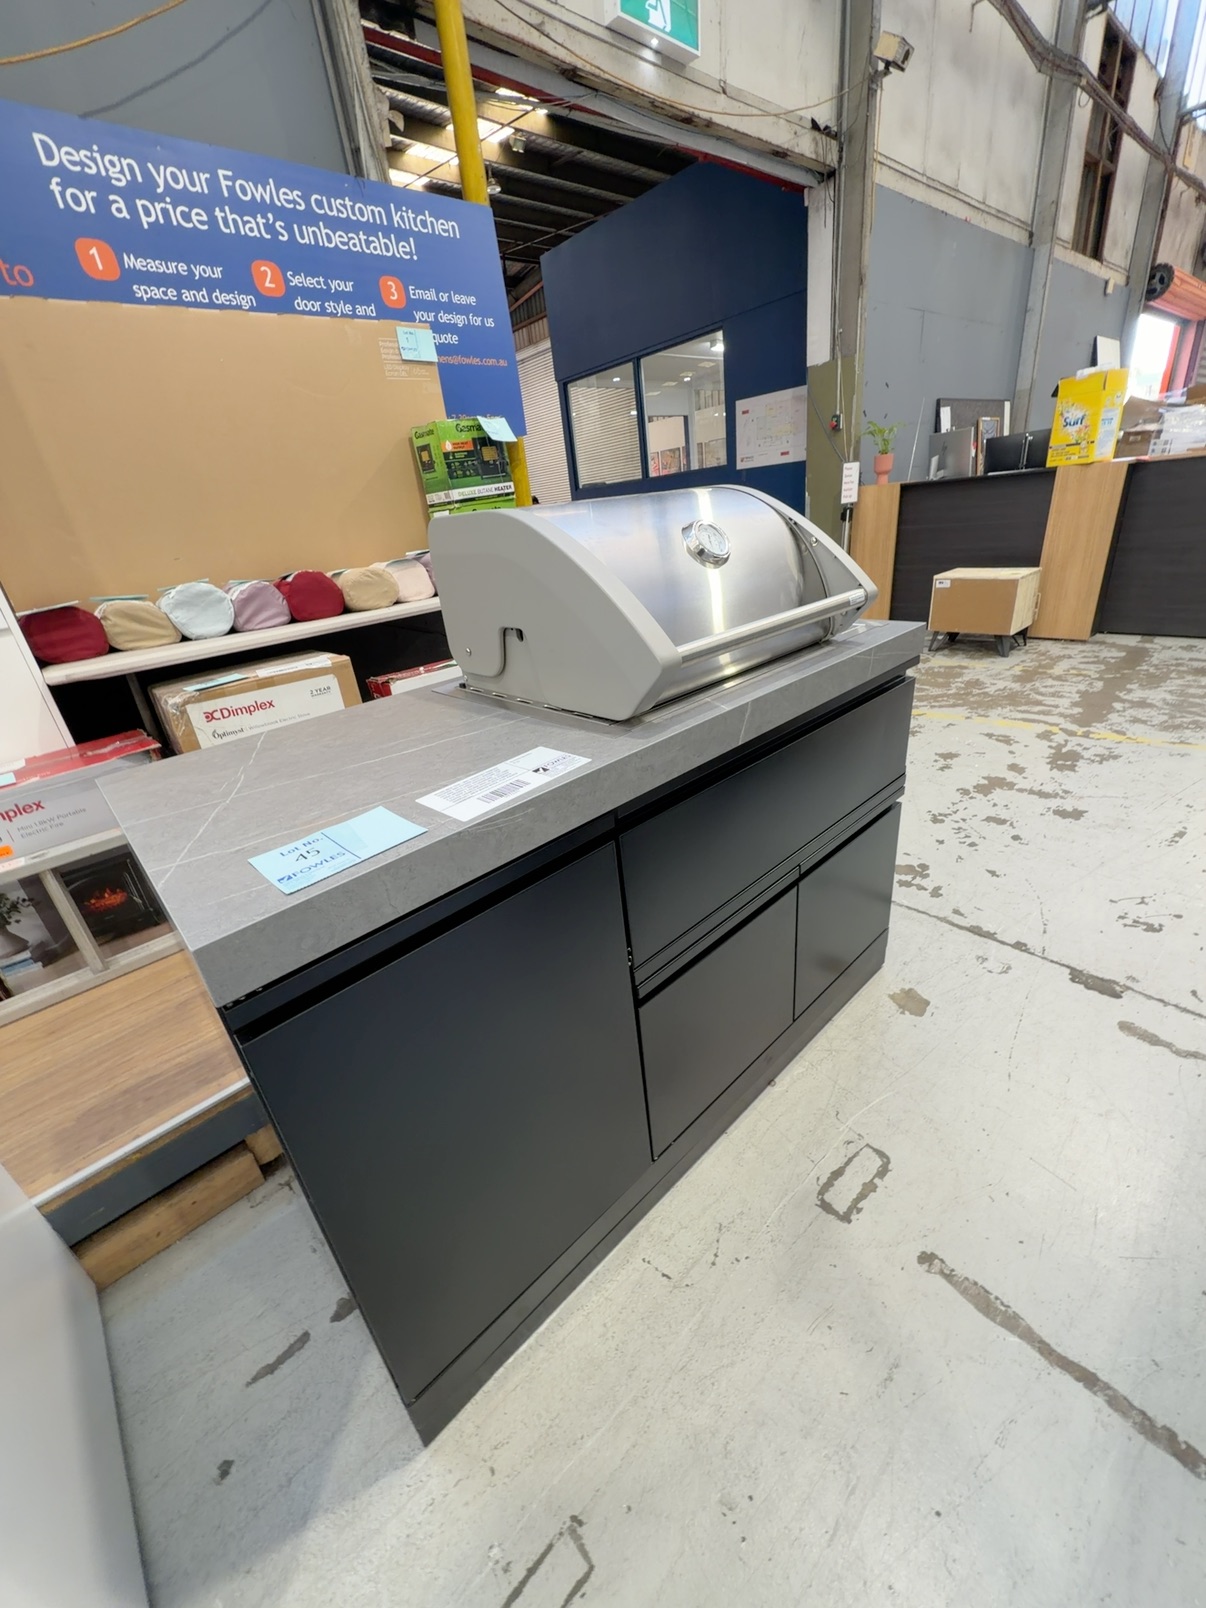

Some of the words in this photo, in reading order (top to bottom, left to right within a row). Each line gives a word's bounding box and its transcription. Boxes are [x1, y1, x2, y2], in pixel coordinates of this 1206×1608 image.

[31, 131, 143, 187] Design
[147, 162, 210, 194] your
[217, 169, 306, 211] Fowles
[311, 194, 387, 226] custom
[390, 203, 461, 239] kitchen
[49, 176, 97, 214] for
[108, 194, 131, 220] a
[135, 196, 209, 230] price
[214, 205, 289, 242] that's
[293, 221, 418, 260] unbeatable!
[88, 246, 103, 271] 1
[123, 252, 188, 276] Measure
[191, 263, 223, 280] your
[0, 259, 35, 287] to
[259, 265, 276, 288] 2
[286, 271, 326, 290] Select
[328, 278, 354, 293] your
[132, 283, 178, 301] space
[181, 287, 209, 304] and
[212, 288, 257, 310] design
[386, 281, 399, 300] 3
[408, 285, 438, 302] Email
[439, 291, 449, 302] or
[450, 290, 477, 306] leave
[294, 296, 322, 312] door
[325, 299, 353, 317] style
[355, 303, 376, 317] and
[413, 310, 436, 324] your
[437, 310, 468, 328] design
[469, 314, 482, 326] for
[485, 317, 495, 328] us
[432, 332, 459, 346] quote
[1063, 413, 1086, 428] Surf
[414, 428, 435, 440] Gasmate
[315, 686, 331, 694] YEAR
[220, 699, 275, 719] Dimplex
[211, 726, 245, 740] Optimyst
[17, 824, 33, 832] Mini
[56, 808, 87, 820] Portable
[20, 827, 48, 839] Electric
[49, 821, 64, 829] Fire
[279, 846, 300, 857] Lot
[302, 837, 324, 848] No.
[295, 847, 321, 862] 45
[291, 851, 346, 877] FOWLES
